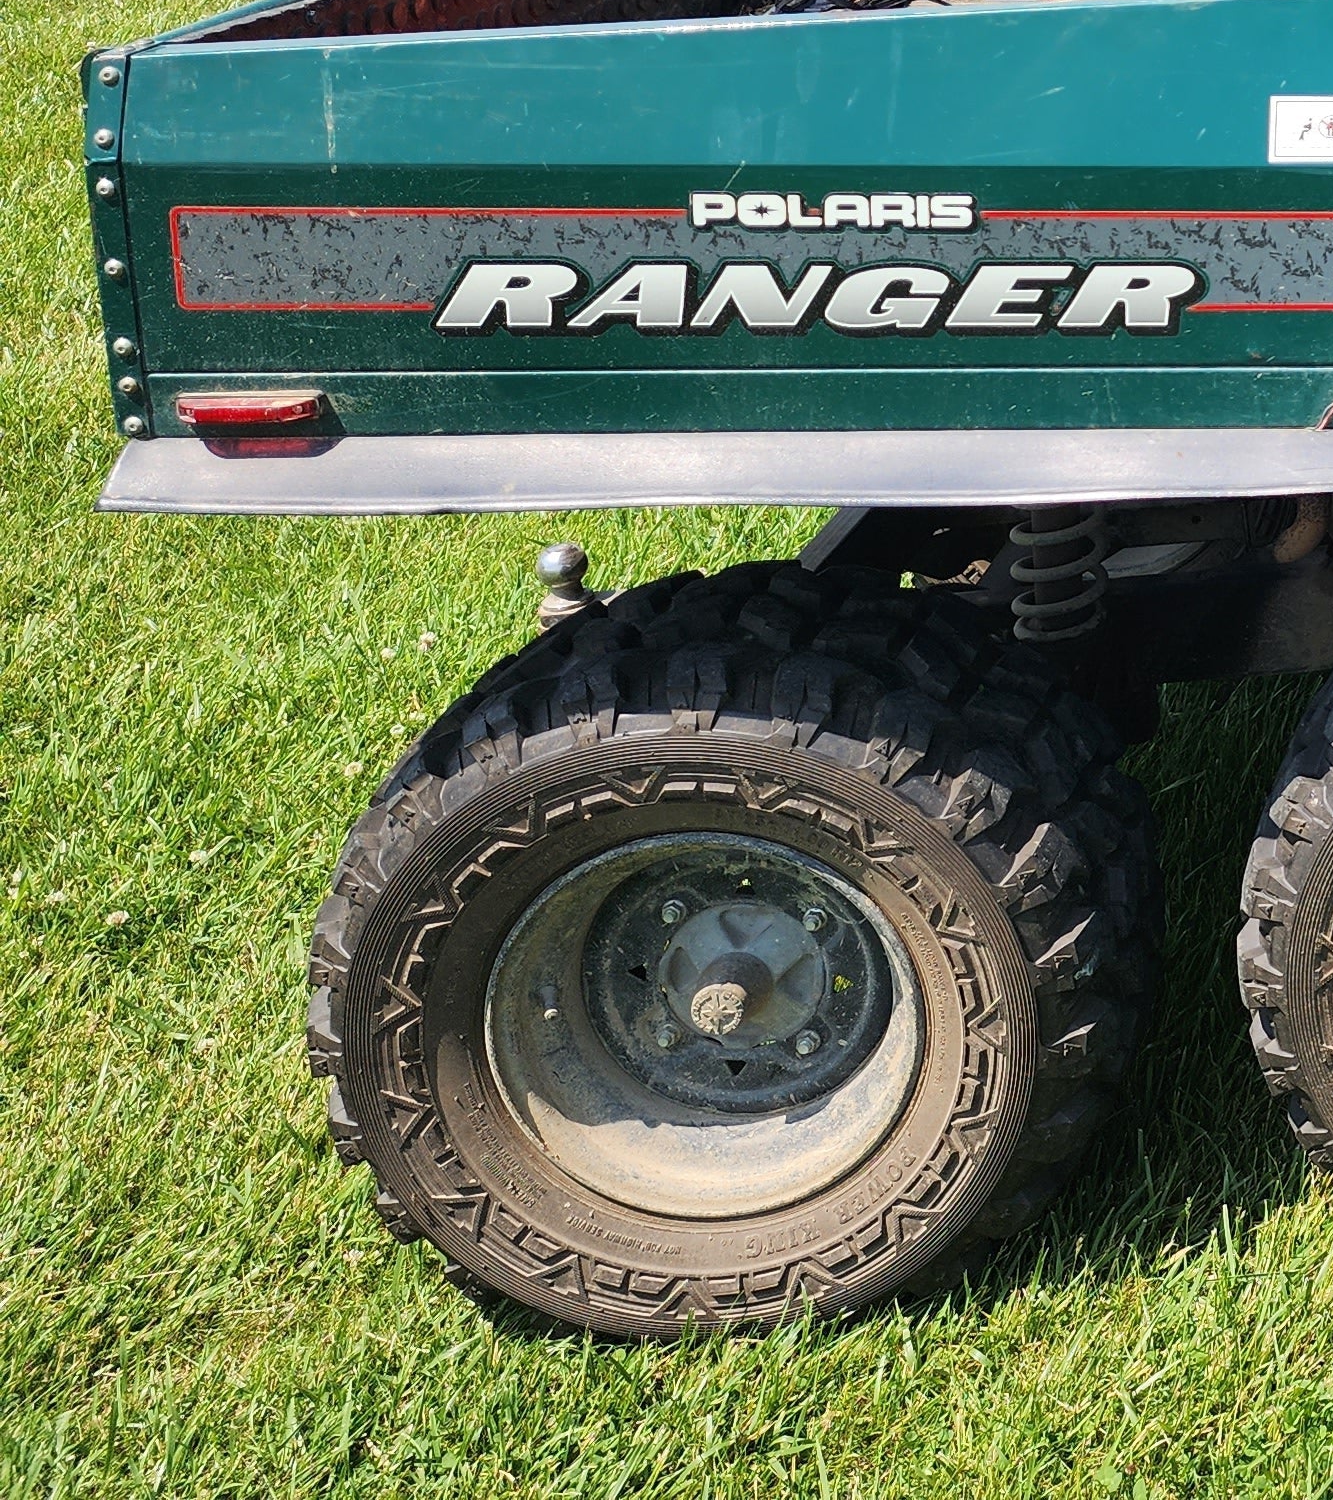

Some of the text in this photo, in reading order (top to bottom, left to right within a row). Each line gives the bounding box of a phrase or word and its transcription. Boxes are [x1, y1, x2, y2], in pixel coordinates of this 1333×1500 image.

[691, 193, 974, 228] POLARIS
[435, 263, 1196, 327] RANGER
[744, 1146, 918, 1259] POWER KING
[565, 1214, 604, 1238] SERVICE
[602, 1229, 643, 1251] HIGHWAY
